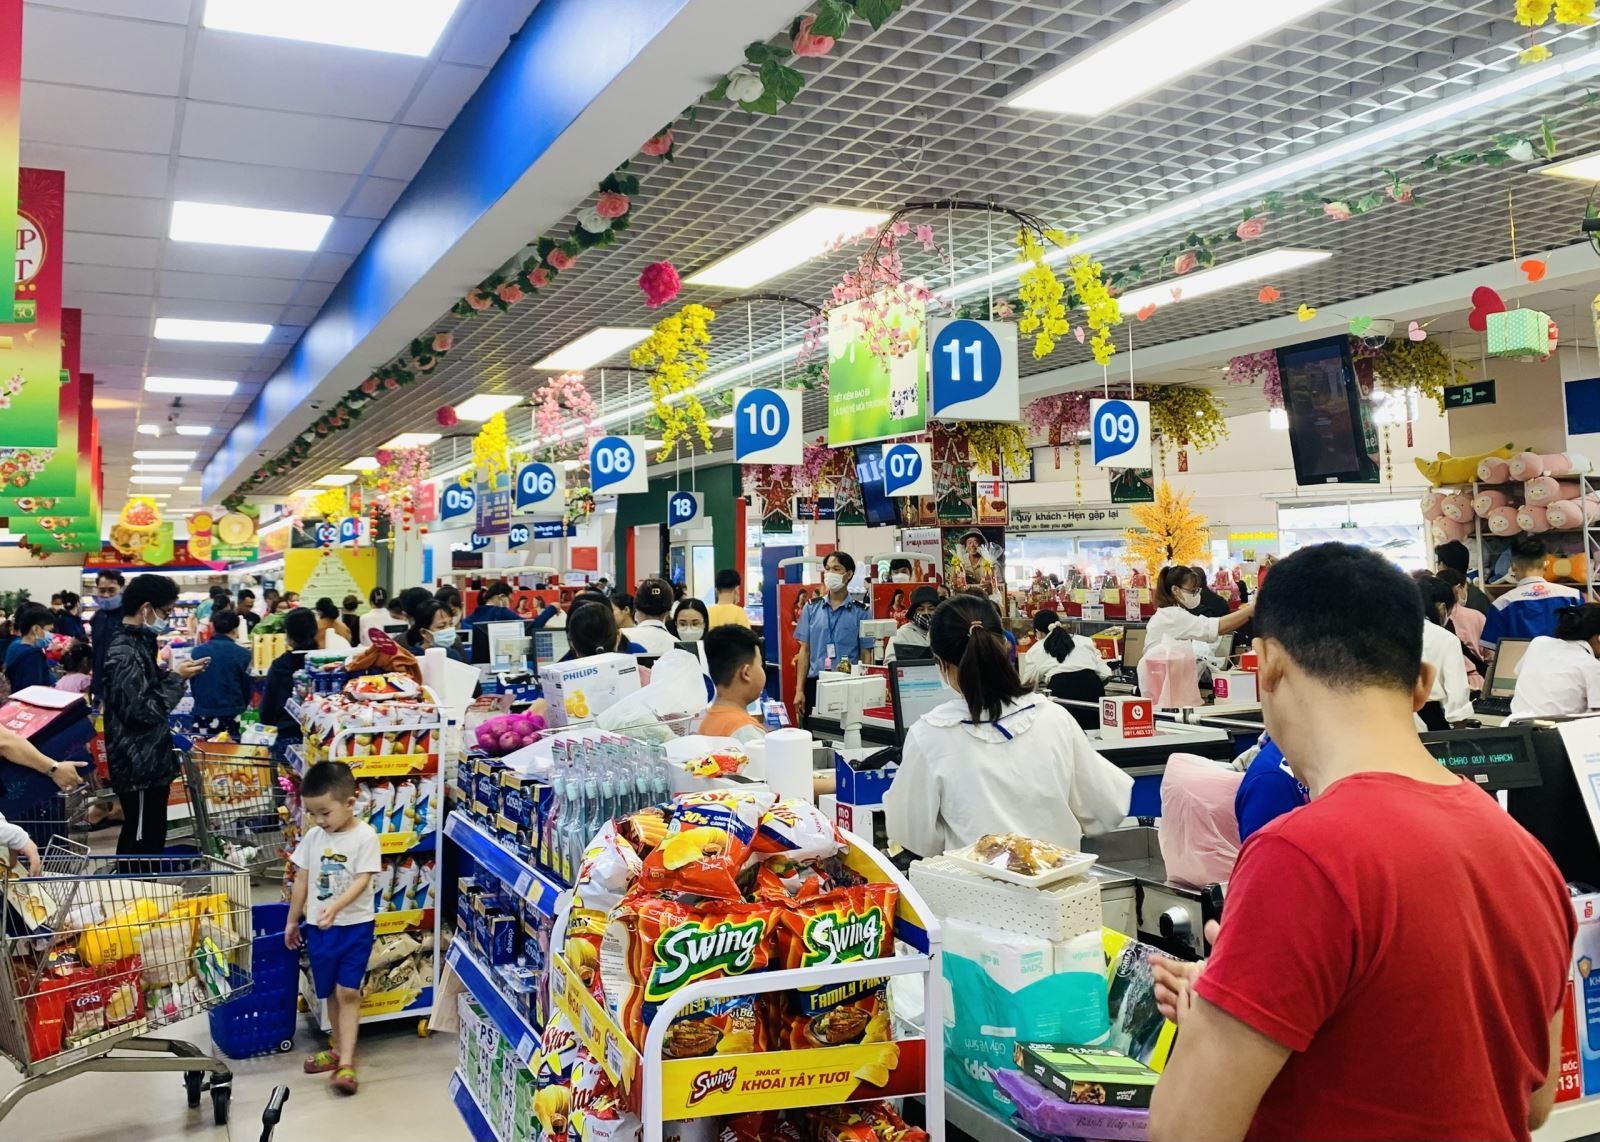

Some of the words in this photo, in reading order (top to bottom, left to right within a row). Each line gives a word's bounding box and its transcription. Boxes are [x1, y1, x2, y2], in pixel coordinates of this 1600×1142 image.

[942, 339, 983, 382] 11
[743, 403, 781, 436] 10
[1101, 412, 1135, 443] 09
[596, 447, 632, 474] 08
[890, 453, 918, 478] 07
[522, 471, 554, 495] 06
[446, 490, 474, 509] 05
[673, 498, 692, 517] 18
[1036, 510, 1061, 521] khách
[1068, 511, 1085, 522] Hẹn
[1088, 510, 1105, 521] gặp
[1108, 510, 1119, 520] lại
[511, 528, 529, 542] 03
[562, 667, 599, 681] PHILIPS
[1449, 757, 1468, 765] CHAO
[1472, 755, 1485, 763] QUY
[1490, 753, 1514, 762] KHACH
[811, 914, 878, 967] Swing
[659, 924, 758, 984] Swing
[811, 981, 856, 1010] FAMILY
[480, 1022, 494, 1046] PS
[693, 1069, 736, 1099] Swing
[741, 1077, 786, 1092] KHOAI
[789, 1073, 815, 1087] TÂY
[818, 1070, 850, 1084] TƯƠI
[755, 1068, 781, 1077] SNACK
